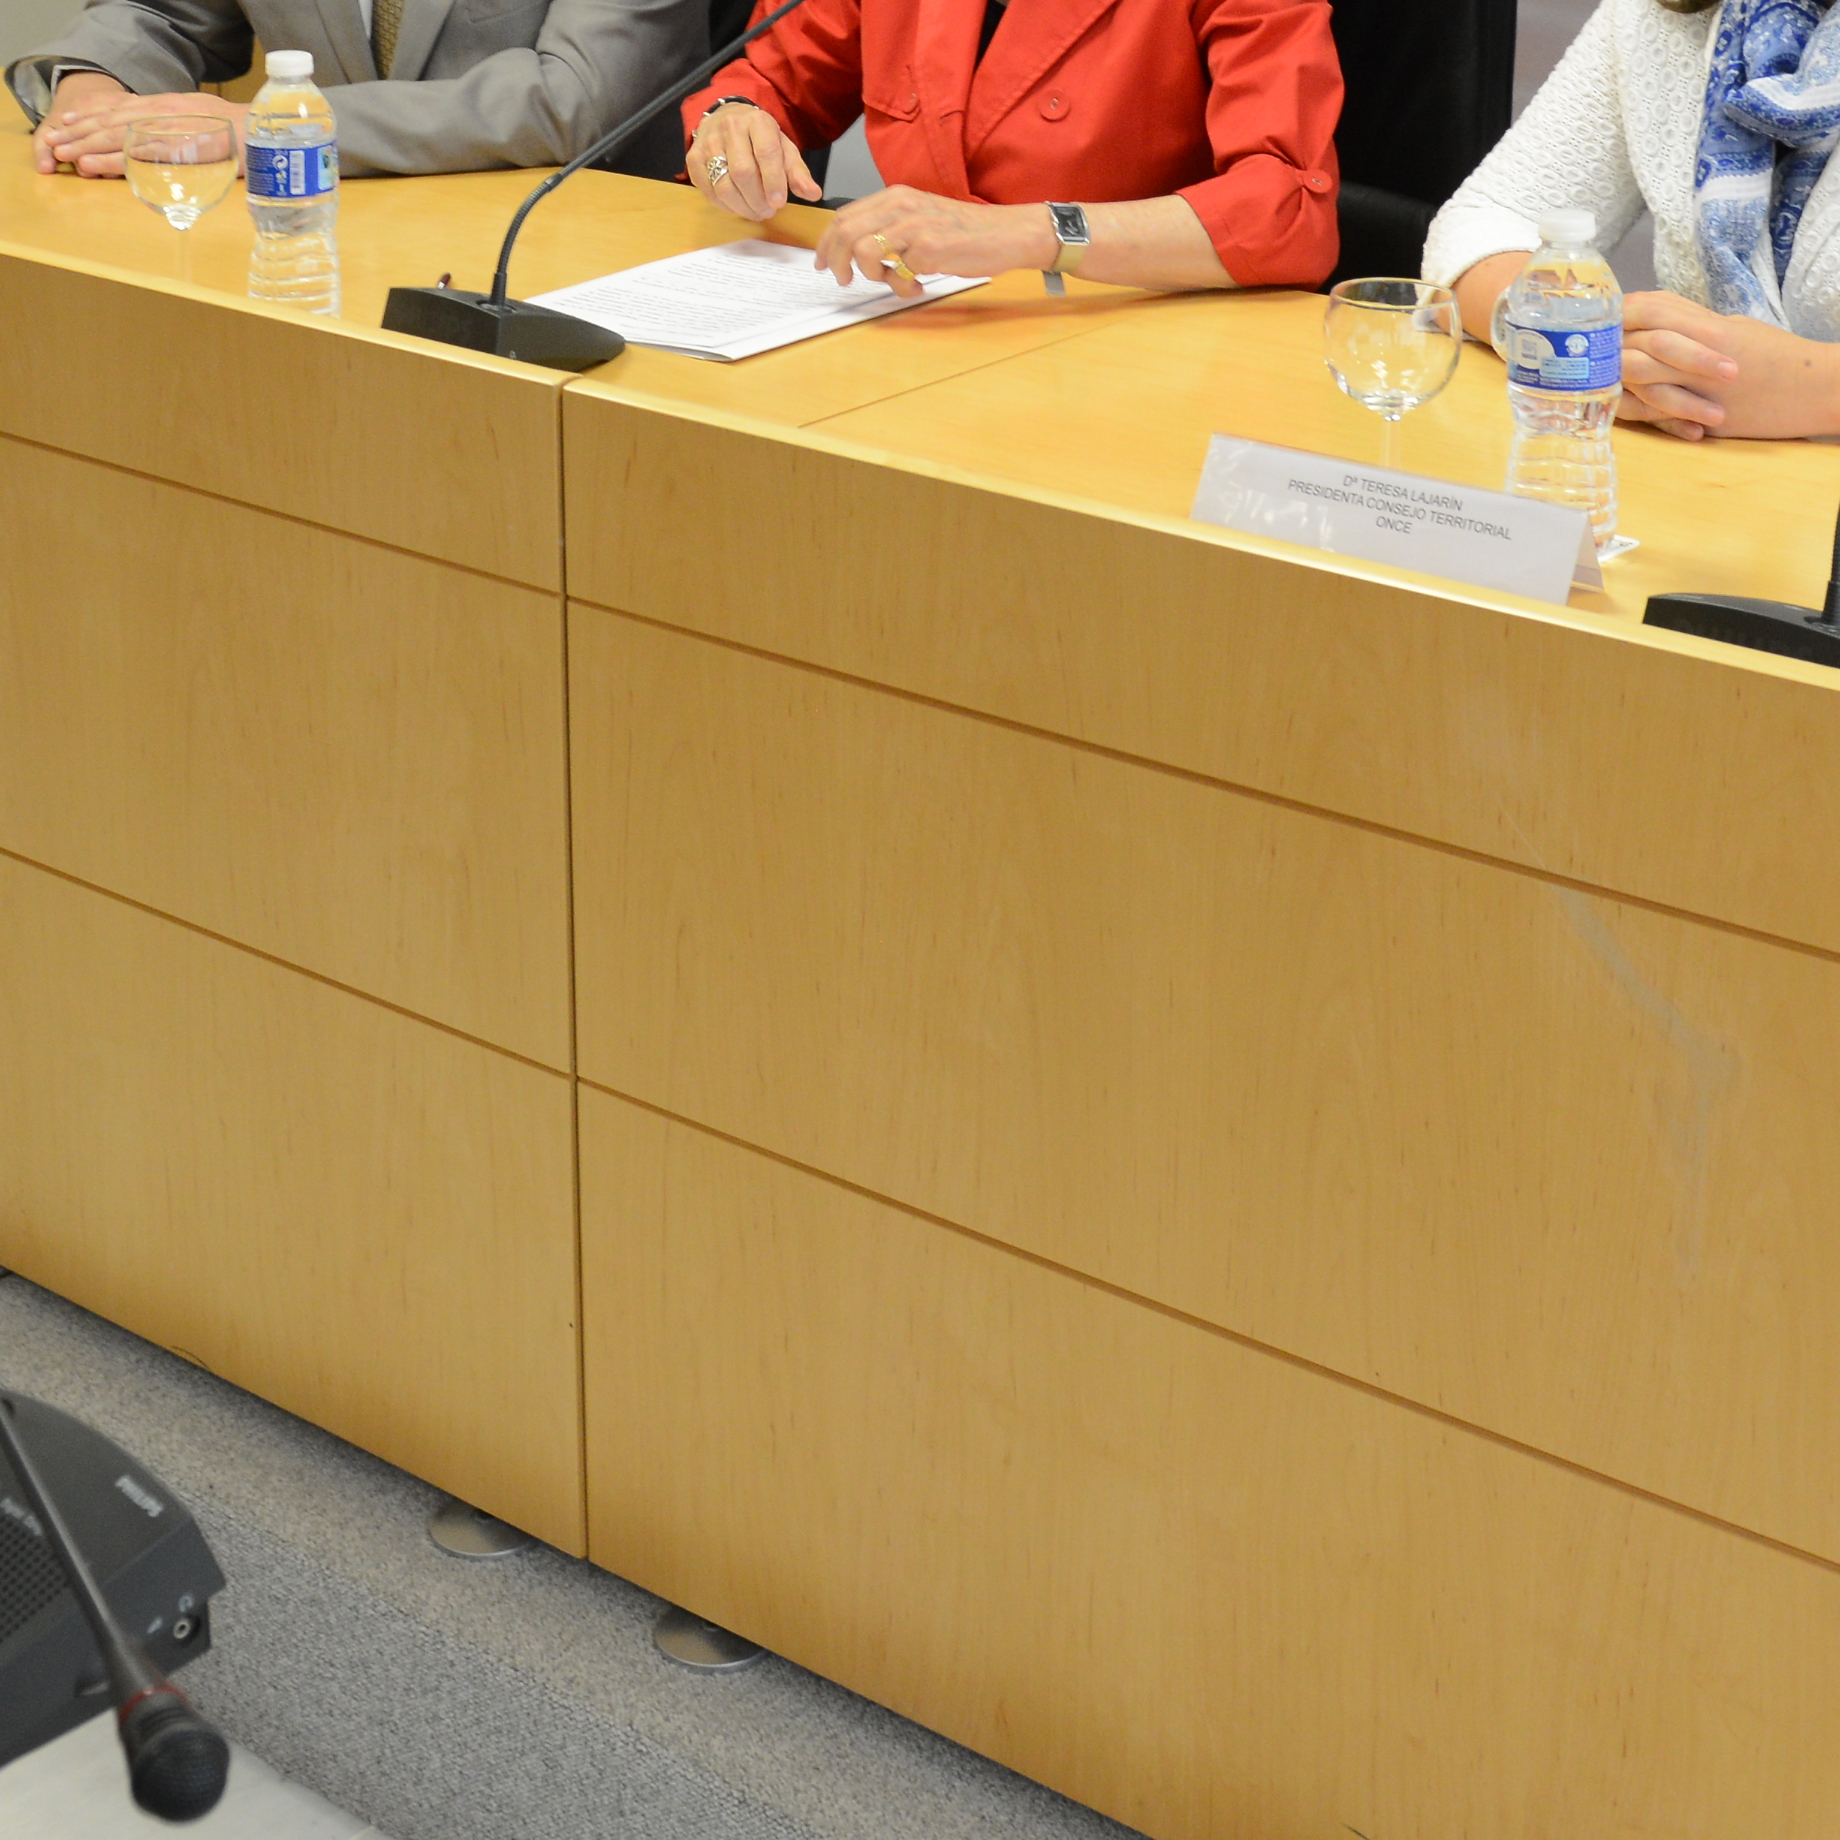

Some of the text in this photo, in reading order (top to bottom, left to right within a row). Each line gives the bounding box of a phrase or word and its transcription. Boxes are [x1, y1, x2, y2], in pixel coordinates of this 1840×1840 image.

[1288, 479, 1512, 540] PRESIDENTA CONSEJO TERRITORIAL
[1342, 474, 1463, 511] Dª TERESA LAJARÍN
[1375, 516, 1413, 534] ONCE
